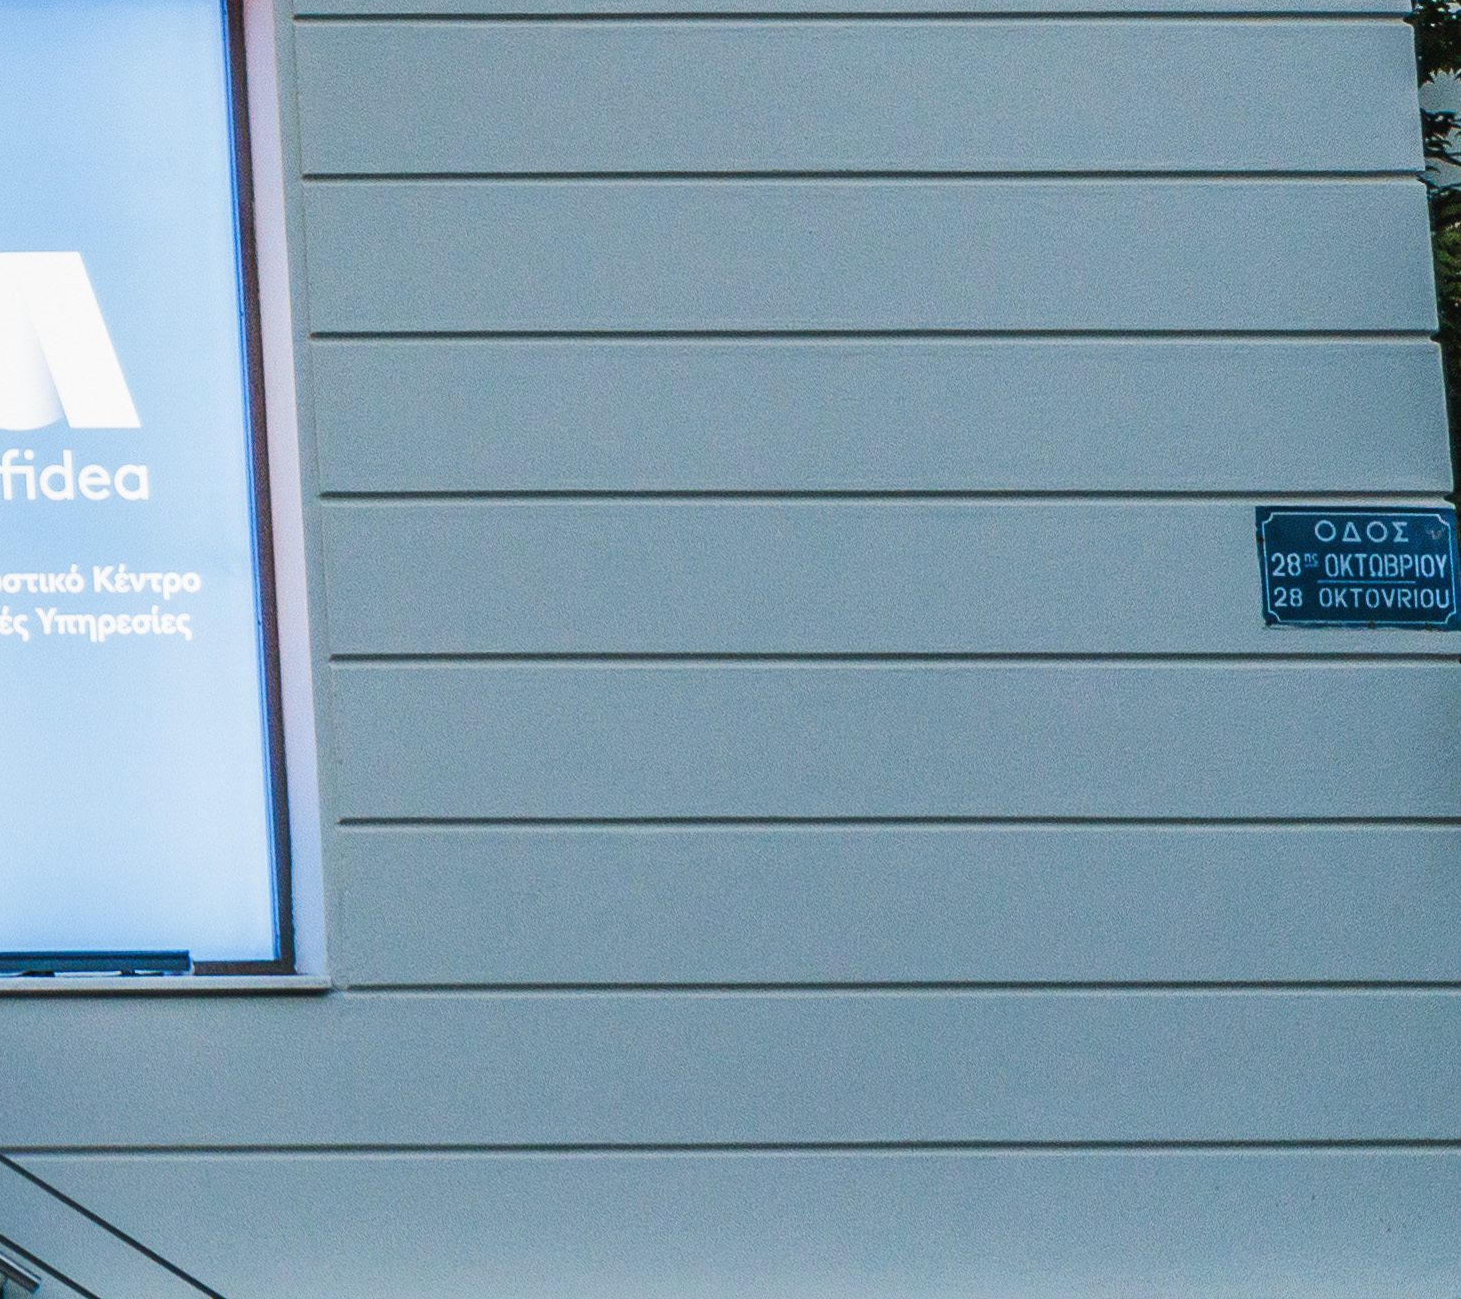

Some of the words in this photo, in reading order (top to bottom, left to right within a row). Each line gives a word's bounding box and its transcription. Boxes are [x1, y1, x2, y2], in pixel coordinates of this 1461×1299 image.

[1314, 519, 1410, 543] ΟΔΟΣ
[1324, 553, 1448, 579] ΟΚΤΩΒΡΙΟΥ
[93, 563, 202, 601] Κέντρο
[1273, 586, 1304, 608] 28
[1318, 587, 1451, 609] OKTOVRIOU
[36, 605, 193, 643] Υπηρεσίες
